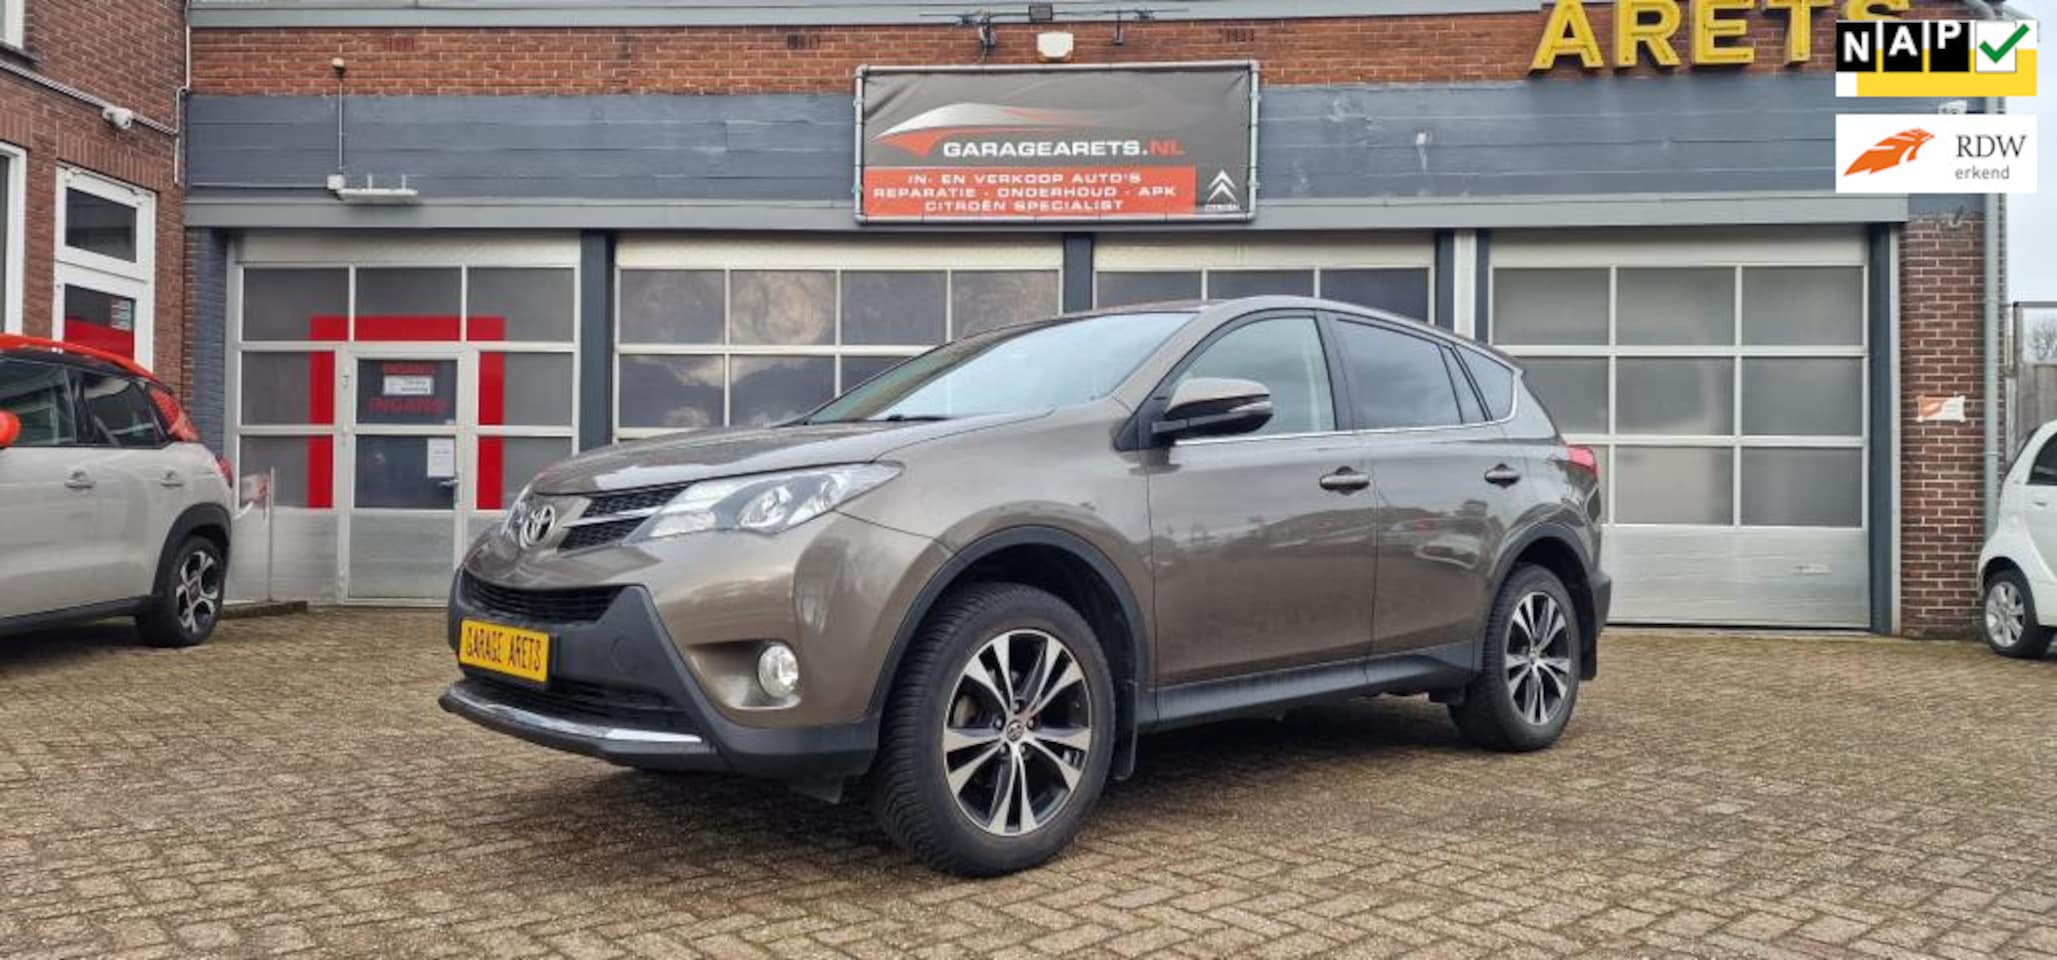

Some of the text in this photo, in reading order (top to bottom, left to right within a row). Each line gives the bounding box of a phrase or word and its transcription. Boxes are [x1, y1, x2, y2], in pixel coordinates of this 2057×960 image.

[1530, 0, 1911, 70] ARET
[943, 141, 1184, 157] GARAGEARETS.NL
[941, 174, 965, 184] EN
[973, 173, 1064, 184] VERKOOP
[1072, 173, 1142, 184] AUTO'S
[873, 187, 976, 199] REPARATIE
[997, 187, 1117, 198] ONDERHOUD
[1138, 186, 1177, 197] APK
[1014, 200, 1124, 211] SPECIALIST
[466, 626, 542, 673] GARAGE ARETS
